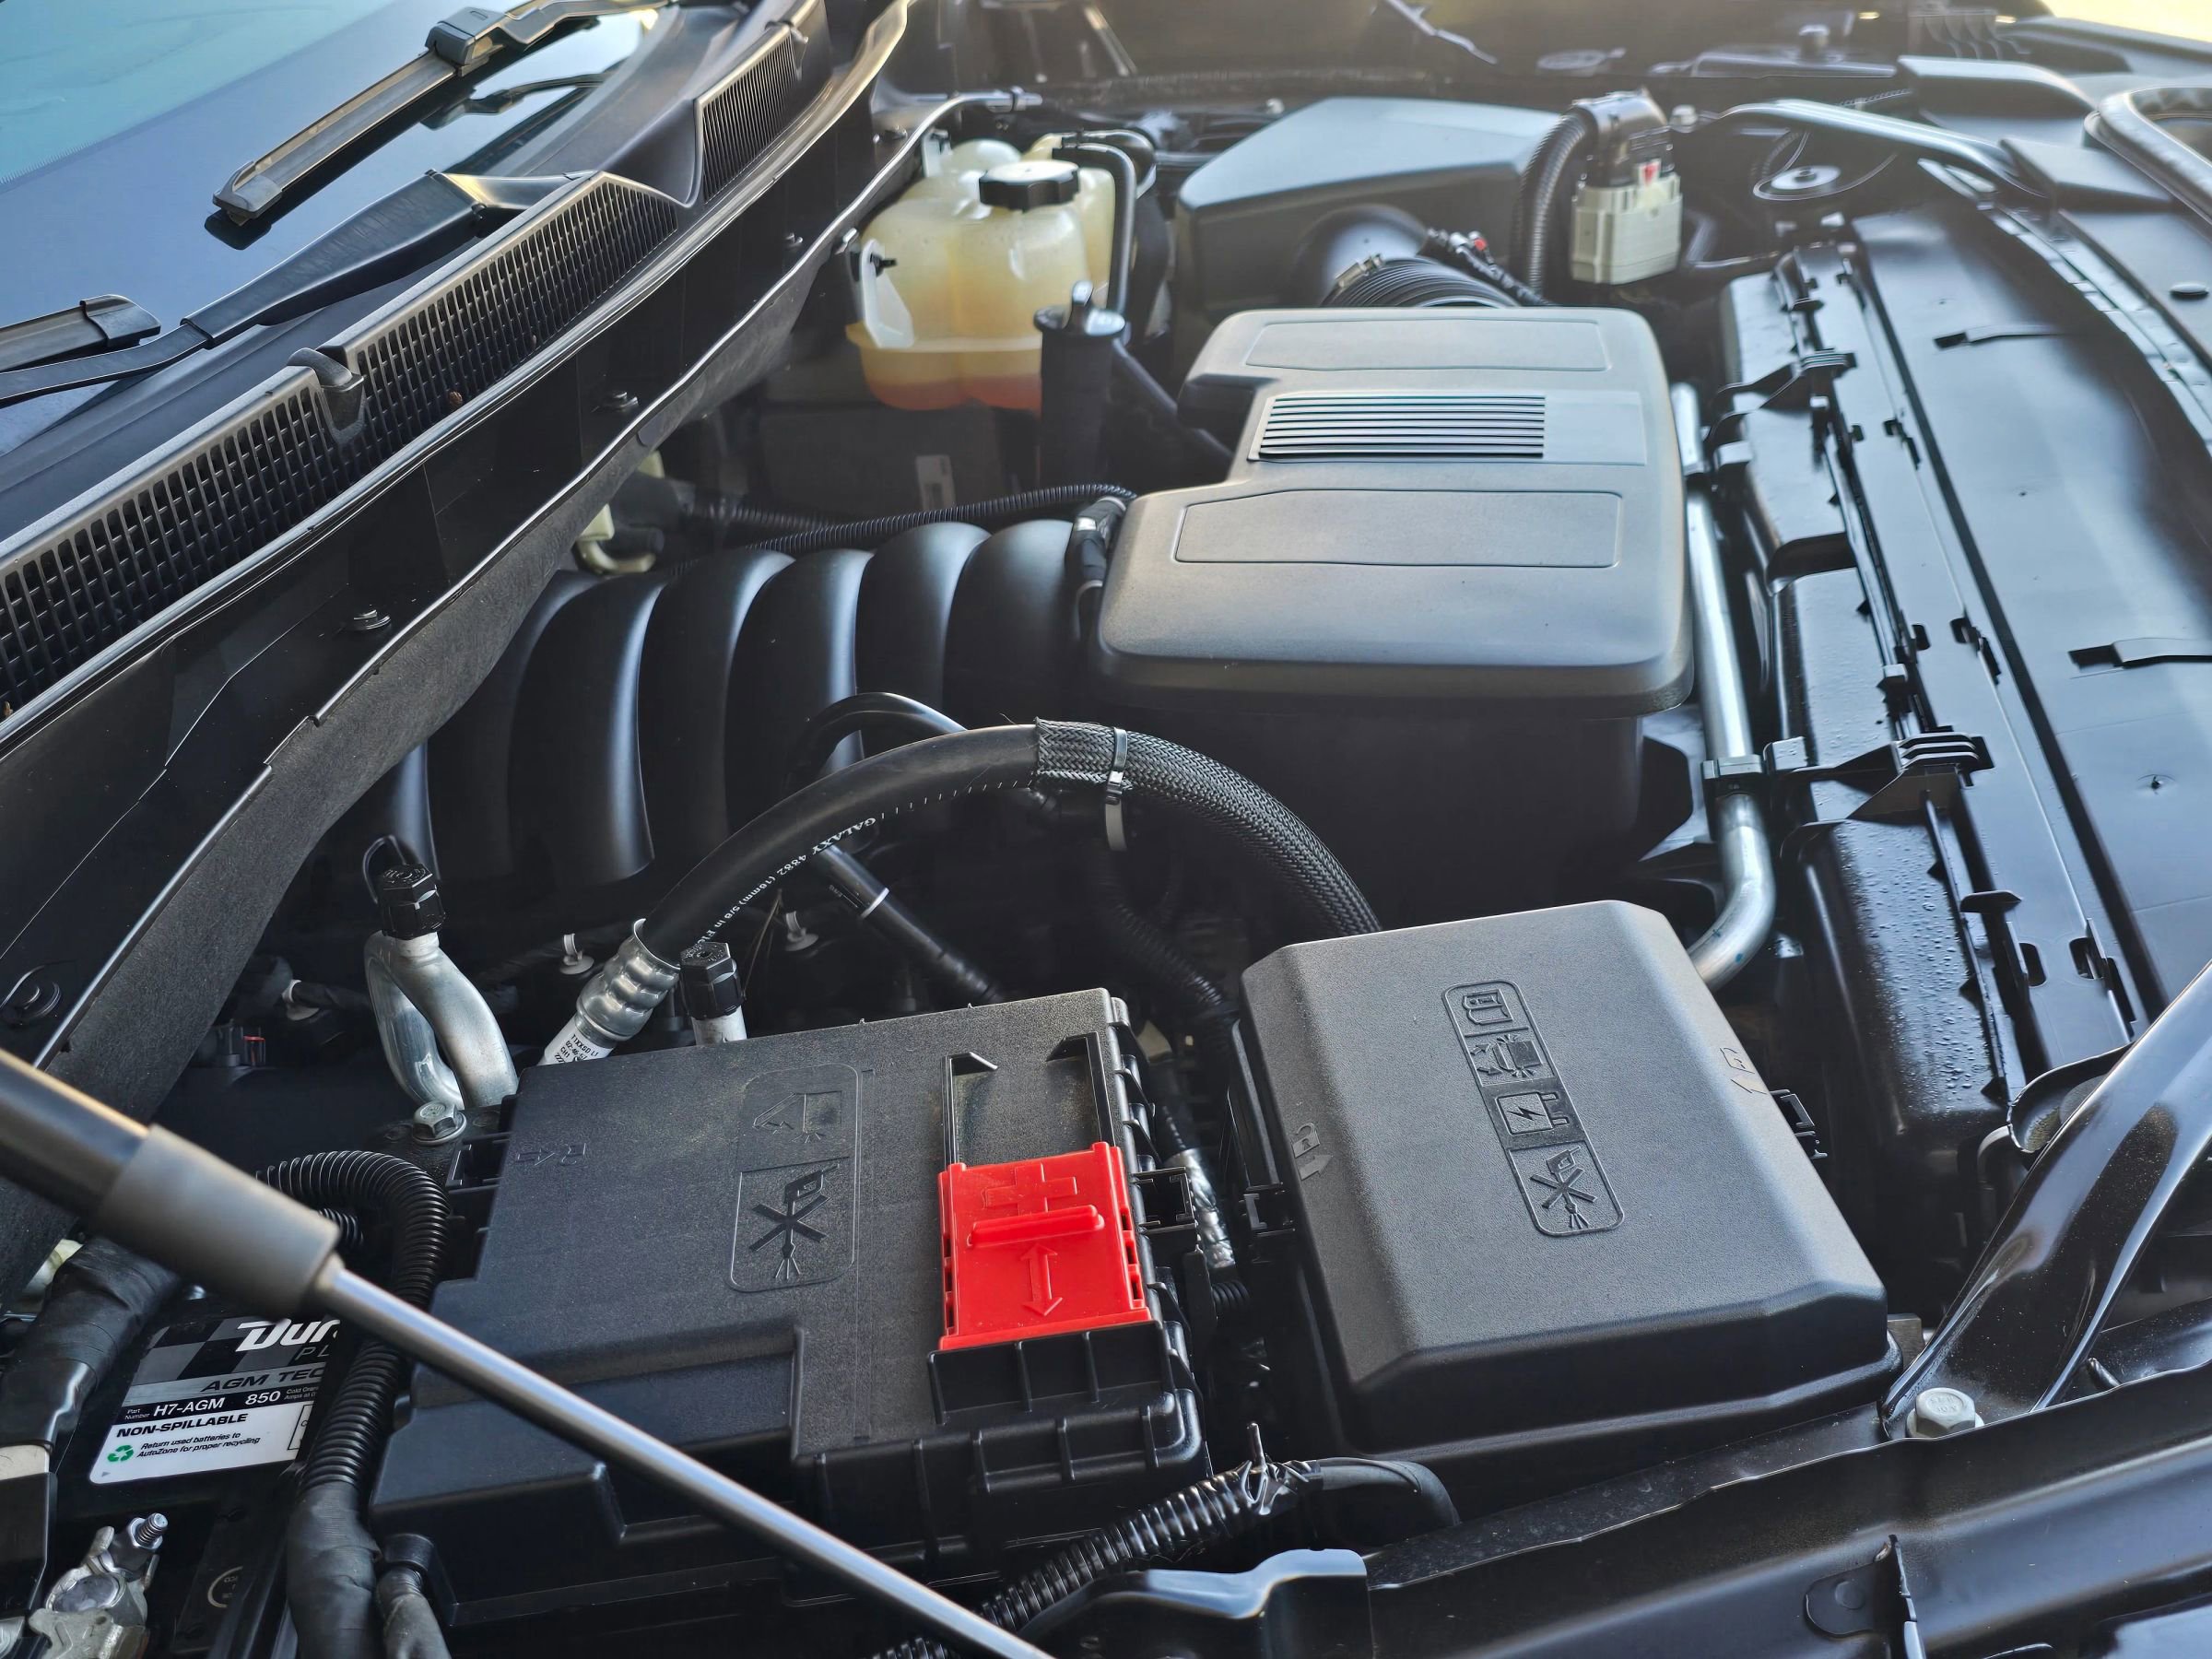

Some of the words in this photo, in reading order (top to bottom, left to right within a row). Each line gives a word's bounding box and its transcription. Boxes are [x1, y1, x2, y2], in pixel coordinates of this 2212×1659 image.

[812, 818, 877, 854] GALAXY
[777, 854, 806, 876] 4882
[738, 876, 776, 905] (16mm)
[235, 1318, 340, 1352] Dur
[200, 1374, 270, 1392] AGM
[153, 1397, 226, 1417] H7-AGM
[245, 1391, 281, 1406] 850
[116, 1413, 249, 1438] NON-SPILLABLE
[136, 1448, 179, 1458] AutoZone
[180, 1444, 192, 1453] for
[192, 1442, 222, 1453] proper
[222, 1438, 261, 1448] recycling
[140, 1441, 171, 1450] Return
[171, 1437, 193, 1446] used
[193, 1434, 230, 1443] batteries
